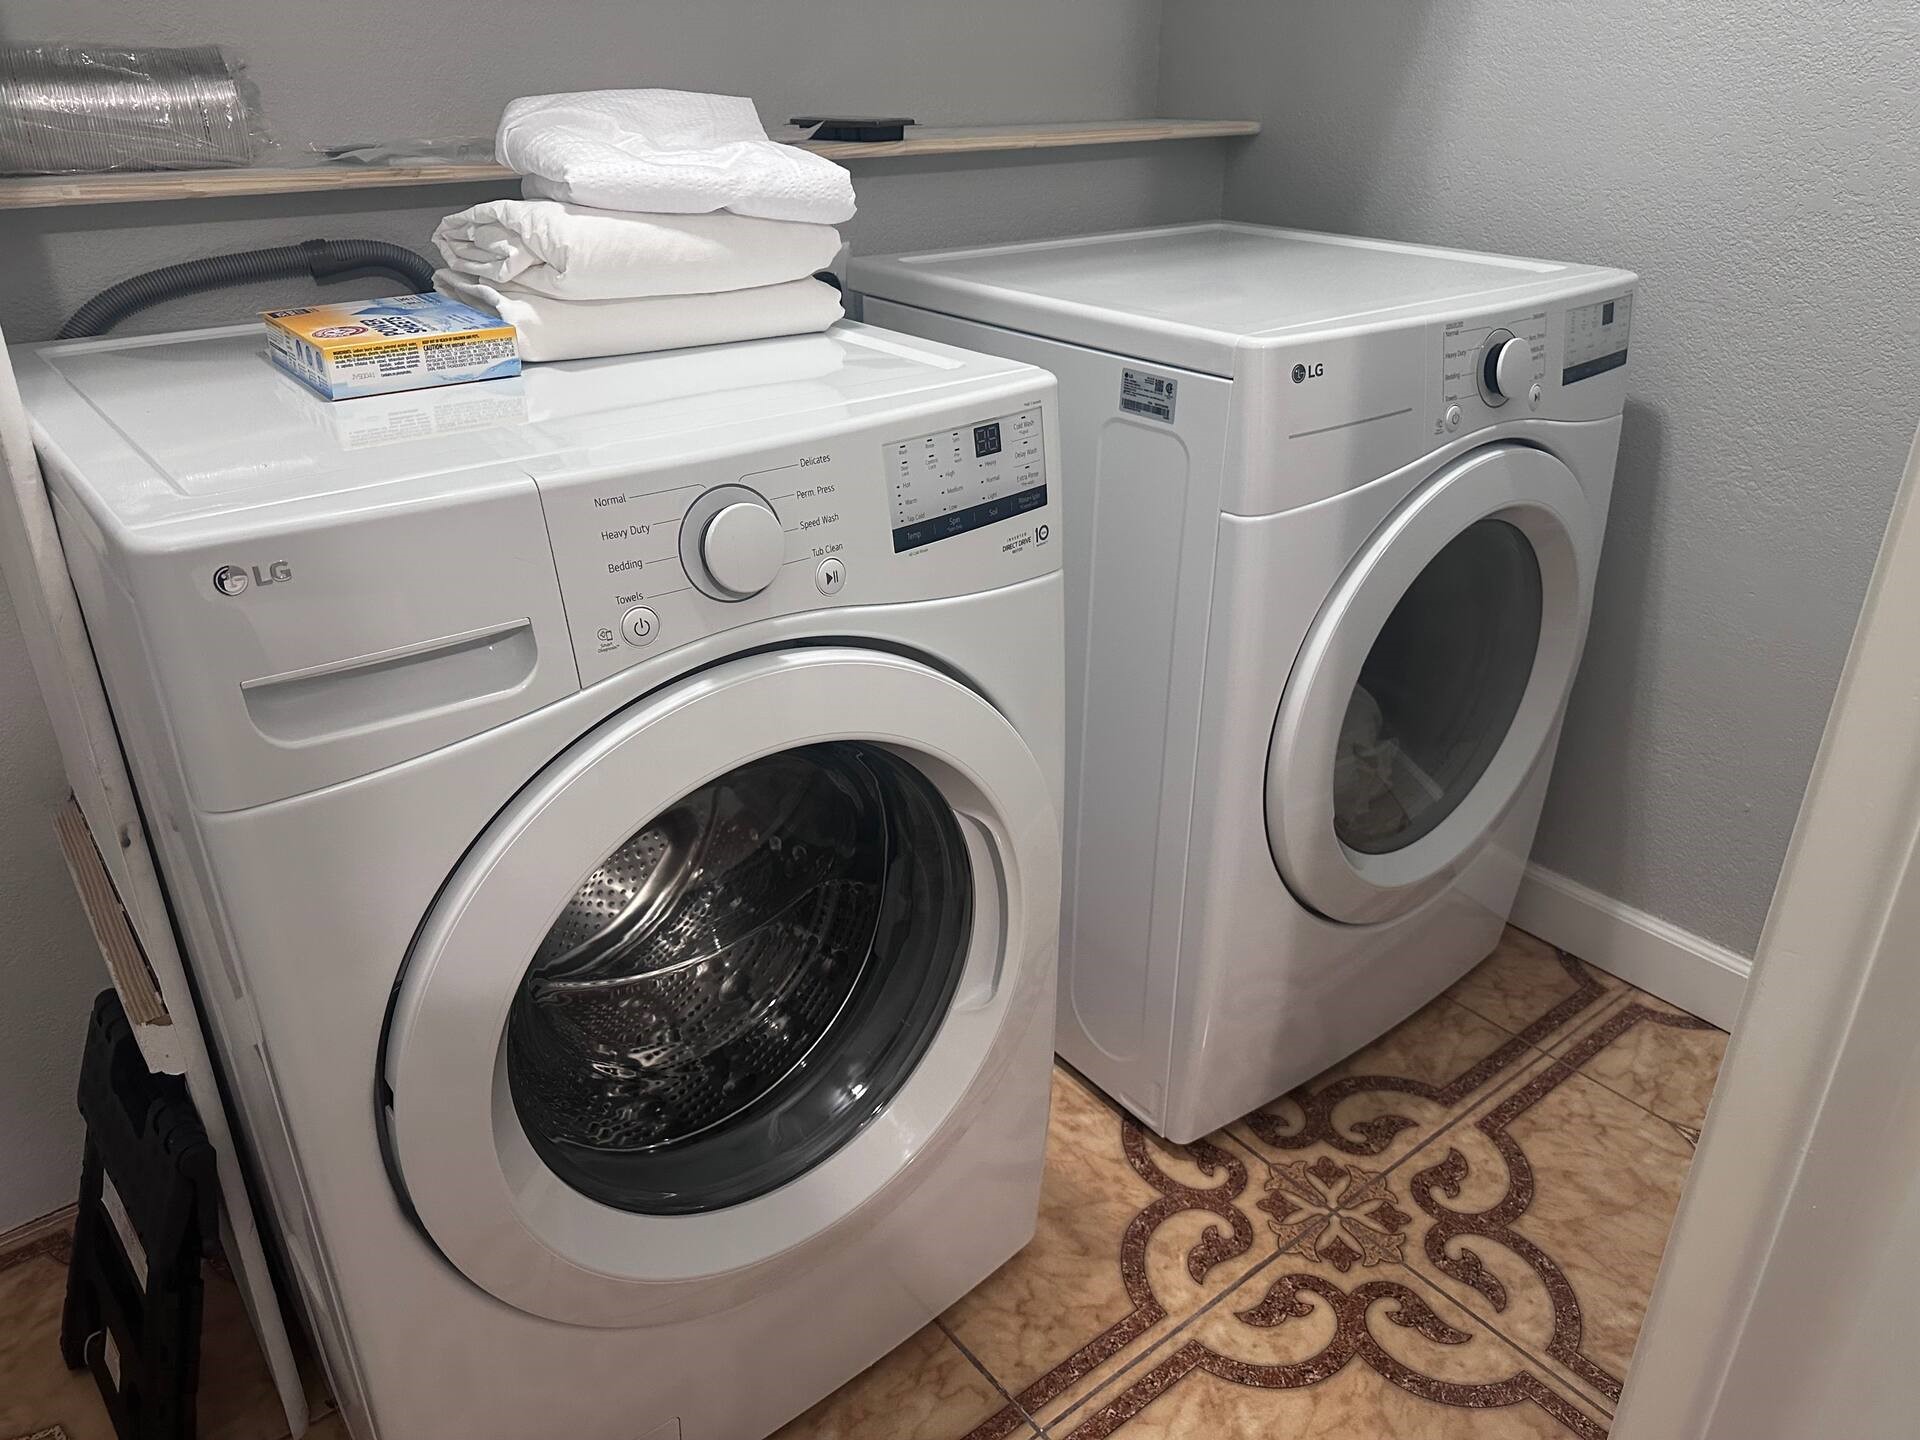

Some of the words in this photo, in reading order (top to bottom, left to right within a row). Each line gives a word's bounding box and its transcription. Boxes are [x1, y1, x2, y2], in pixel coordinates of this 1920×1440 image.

[1308, 363, 1324, 378] LG
[800, 454, 830, 468] Delicates
[796, 490, 815, 500] Perm.
[817, 484, 835, 494] Press
[594, 493, 626, 508] Normal
[800, 517, 820, 530] Speed
[822, 513, 840, 524] Wash
[601, 528, 628, 541] Heavy
[630, 524, 650, 536] Duty
[812, 548, 824, 558] Tub
[825, 543, 844, 554] Clean
[1002, 542, 1018, 552] DIRECT
[1018, 536, 1032, 546] DRIVE
[252, 561, 292, 586] LG
[608, 560, 643, 574] Bedding
[616, 592, 644, 605] Towels
